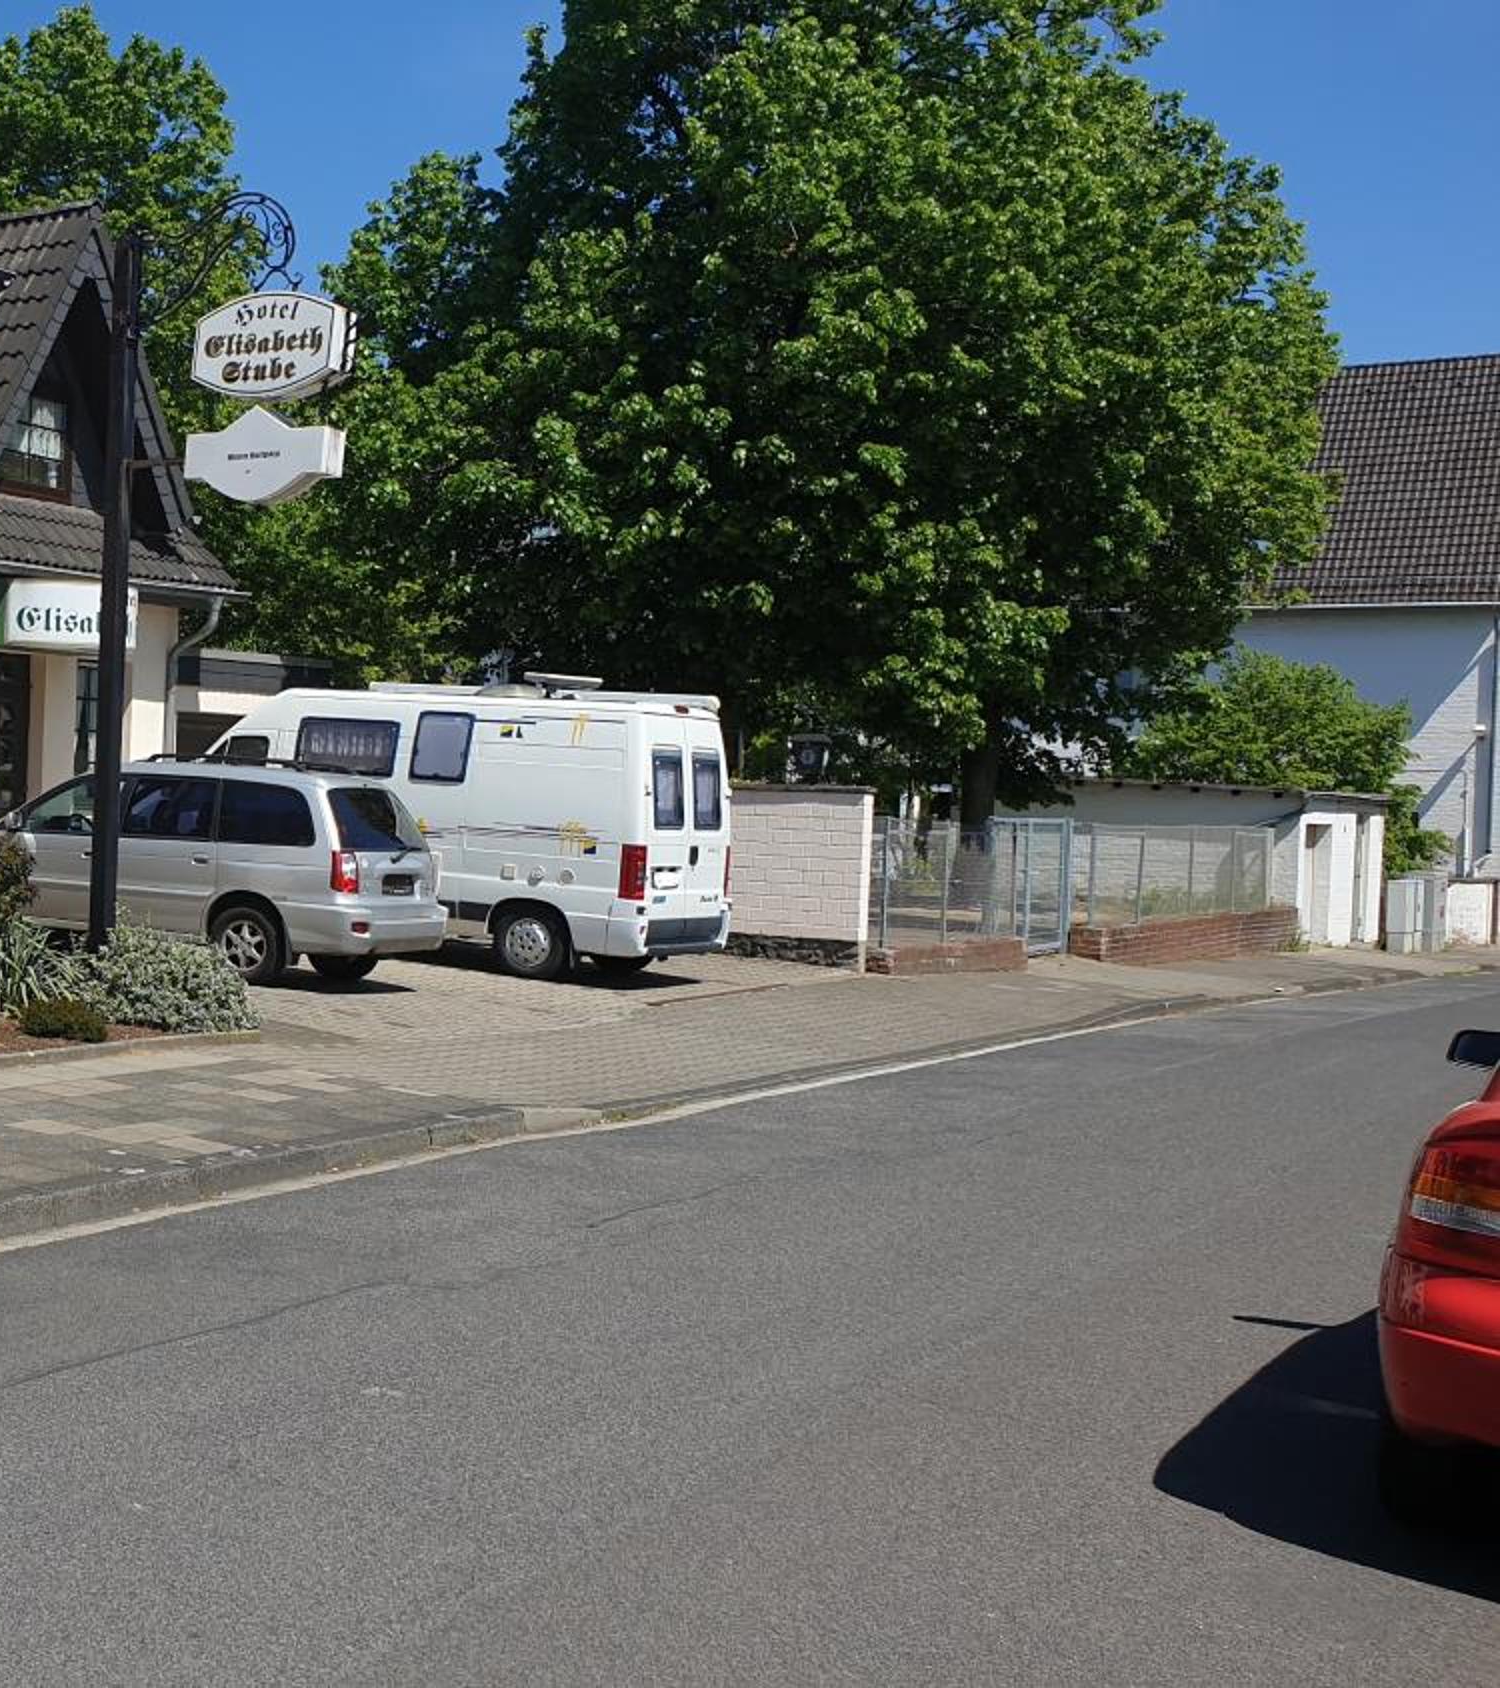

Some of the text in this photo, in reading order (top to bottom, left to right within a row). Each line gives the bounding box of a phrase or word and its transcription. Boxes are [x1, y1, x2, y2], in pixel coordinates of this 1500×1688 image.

[235, 300, 300, 326] Hotel
[204, 325, 324, 359] Elisabeth
[221, 357, 297, 383] Stube
[16, 607, 102, 633] Elisa
